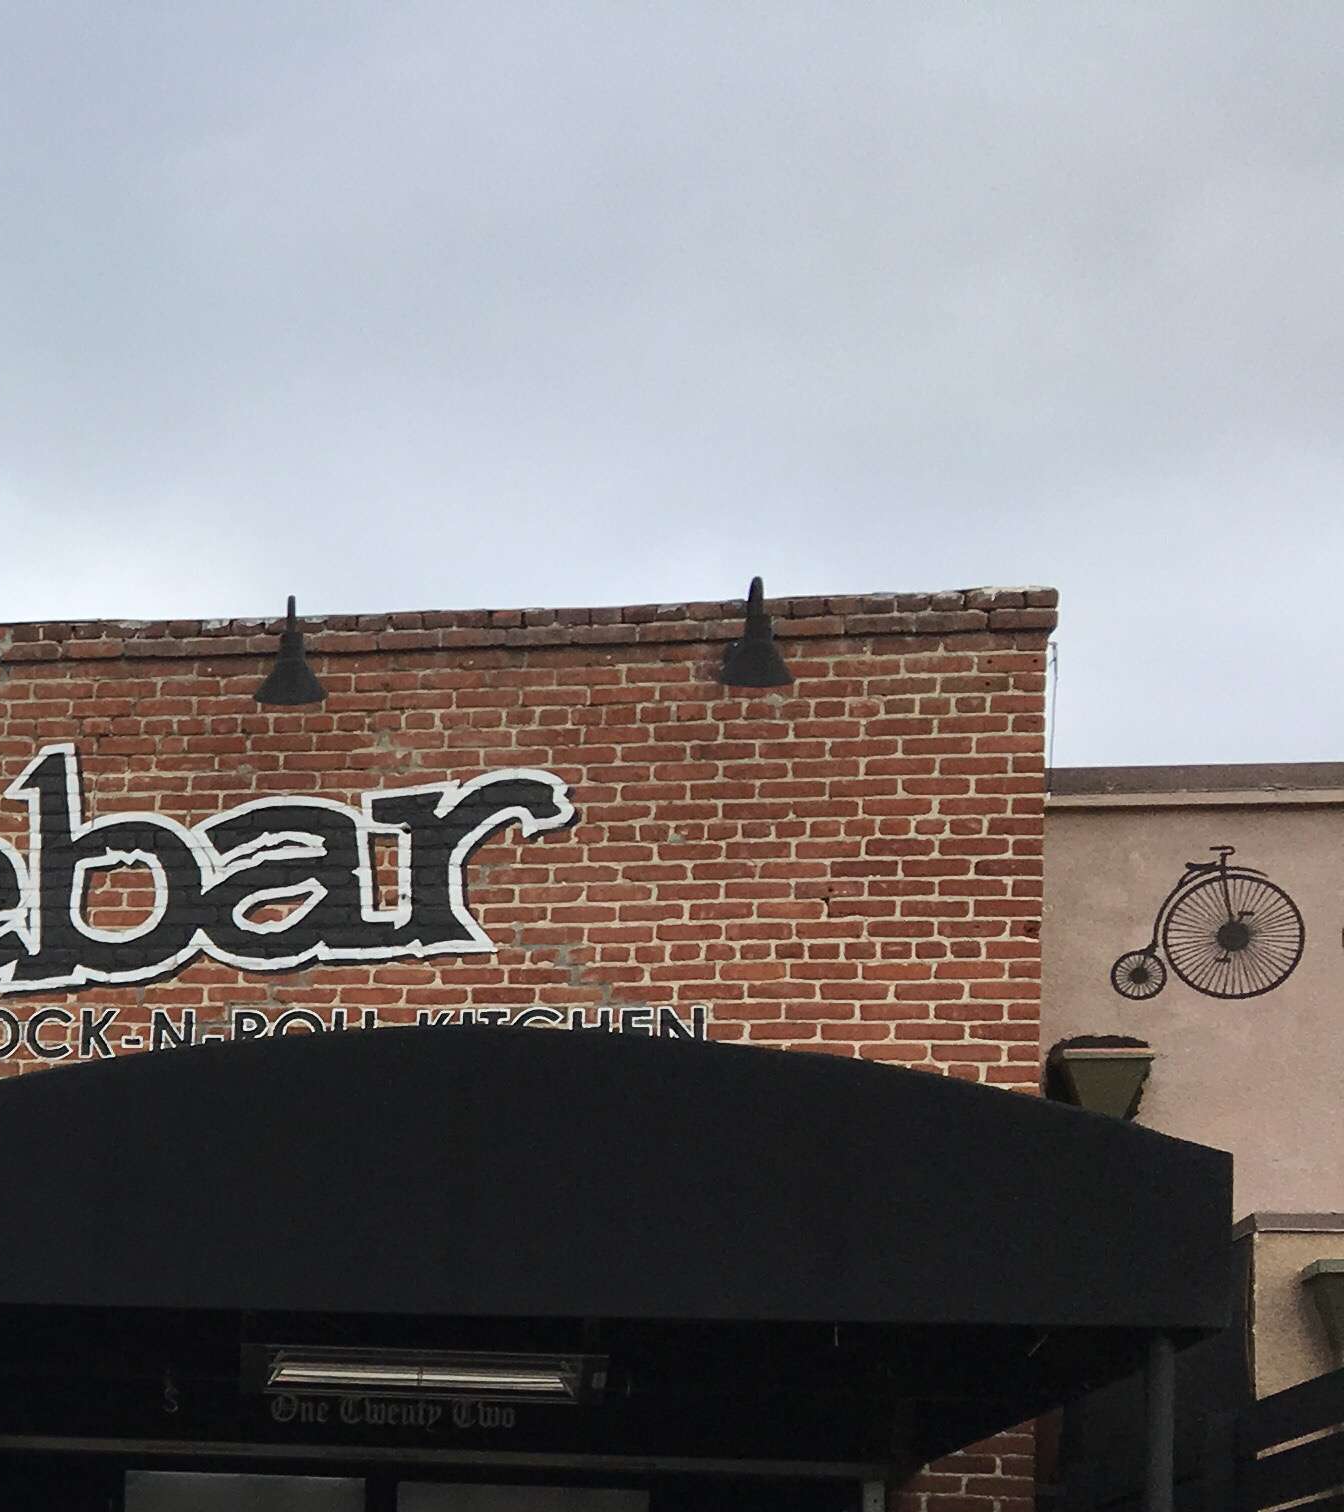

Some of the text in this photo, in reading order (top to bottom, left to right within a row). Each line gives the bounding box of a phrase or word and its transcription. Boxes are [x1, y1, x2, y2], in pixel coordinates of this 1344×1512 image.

[270, 1393, 517, 1432] One Twenty Two
